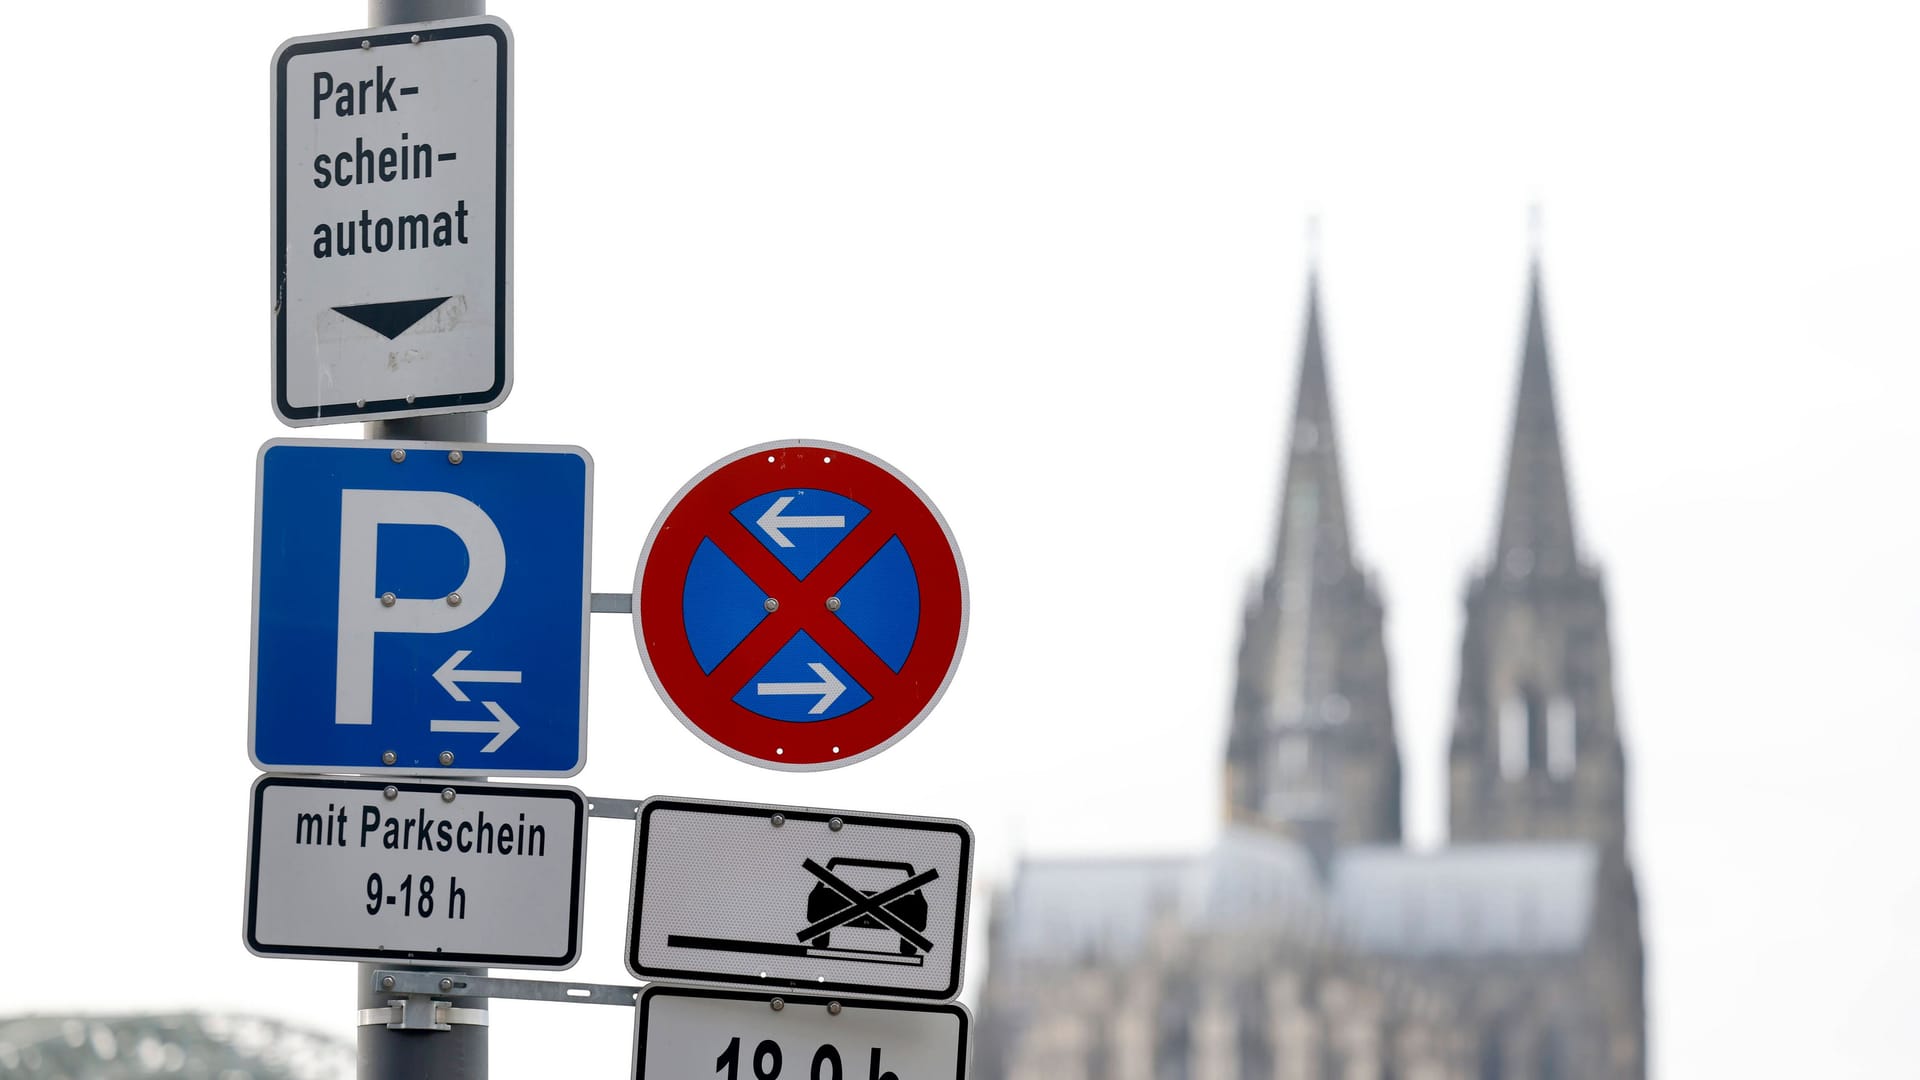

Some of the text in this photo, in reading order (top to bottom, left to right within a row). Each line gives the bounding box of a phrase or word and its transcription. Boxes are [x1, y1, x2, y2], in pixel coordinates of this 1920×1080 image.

[313, 65, 419, 120] Park-
[313, 132, 457, 189] schein-
[313, 199, 469, 259] automat
[335, 488, 507, 725] P
[295, 803, 547, 857] mit Parkschein
[366, 872, 466, 920] 9-18 h
